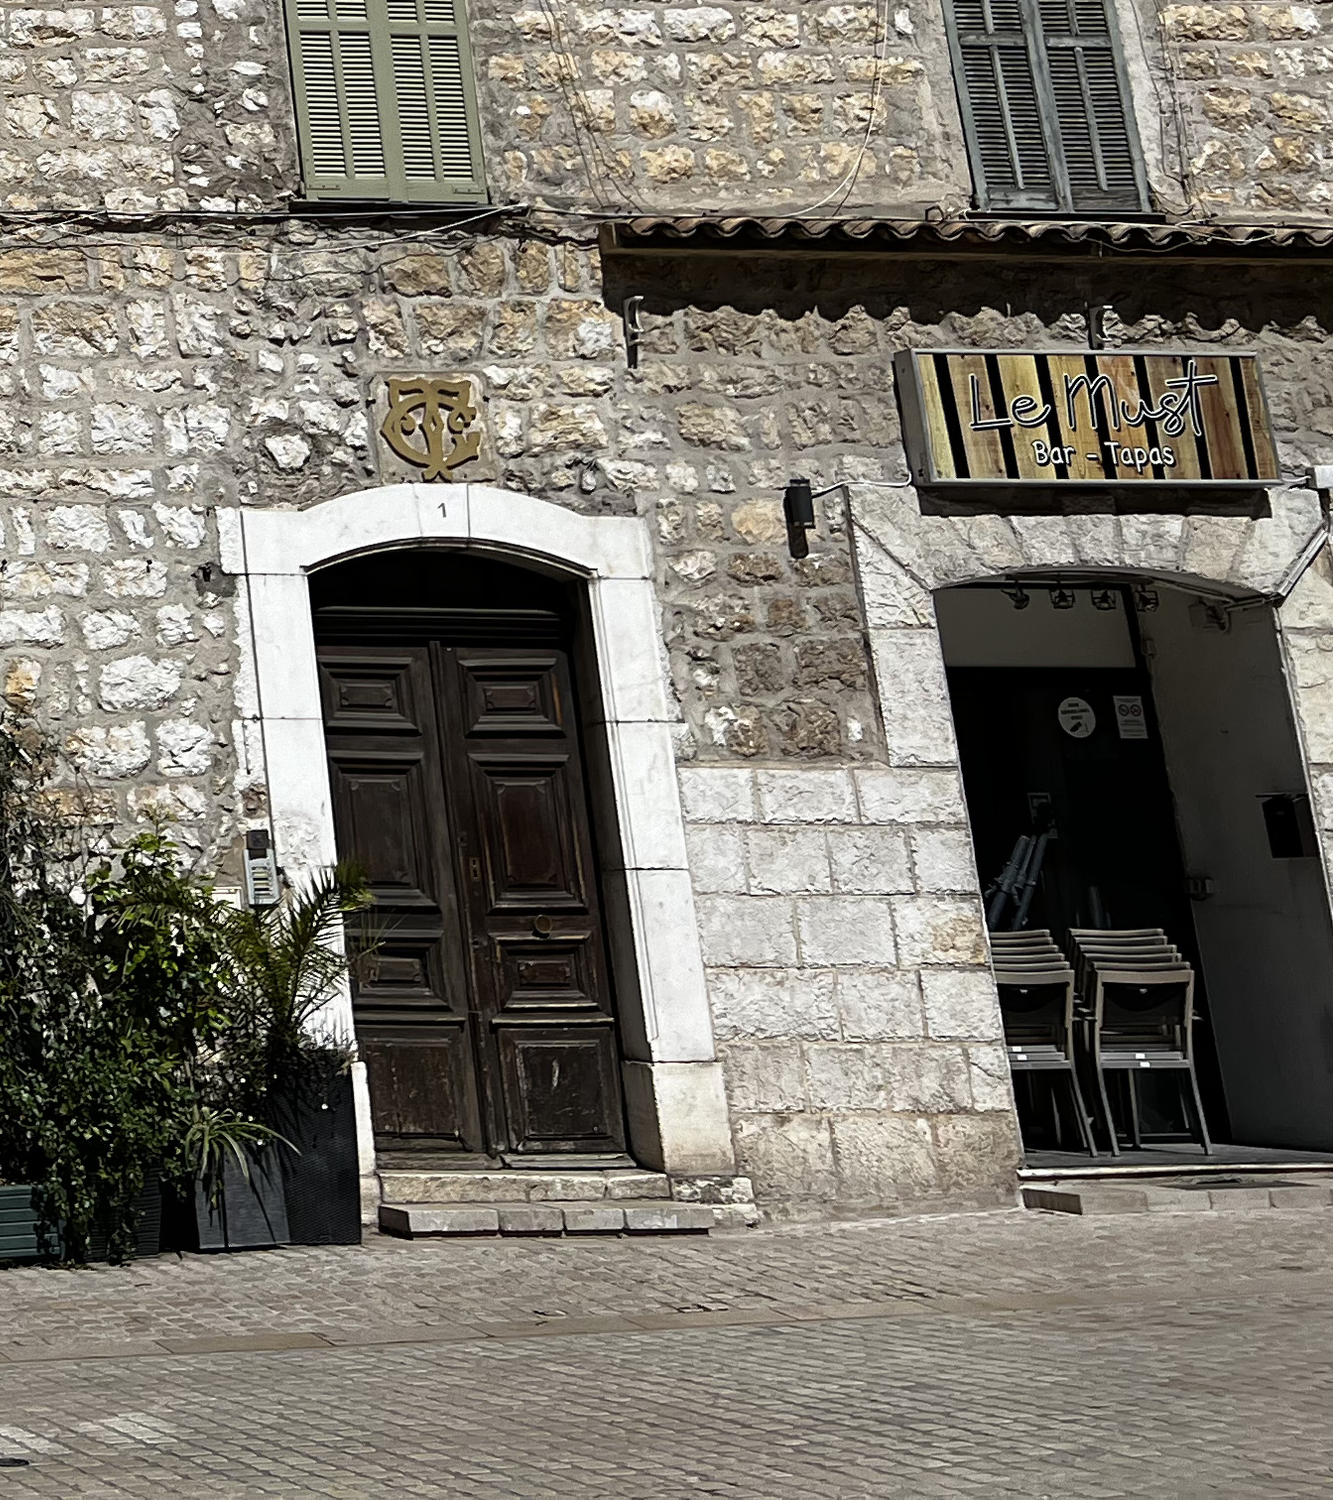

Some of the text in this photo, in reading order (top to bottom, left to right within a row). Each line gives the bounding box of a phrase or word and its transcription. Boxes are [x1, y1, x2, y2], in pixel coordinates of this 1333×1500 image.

[969, 359, 1220, 437] Le Must
[1032, 441, 1076, 466] Bar
[1105, 442, 1176, 472] Tapas
[436, 502, 447, 518] 1
